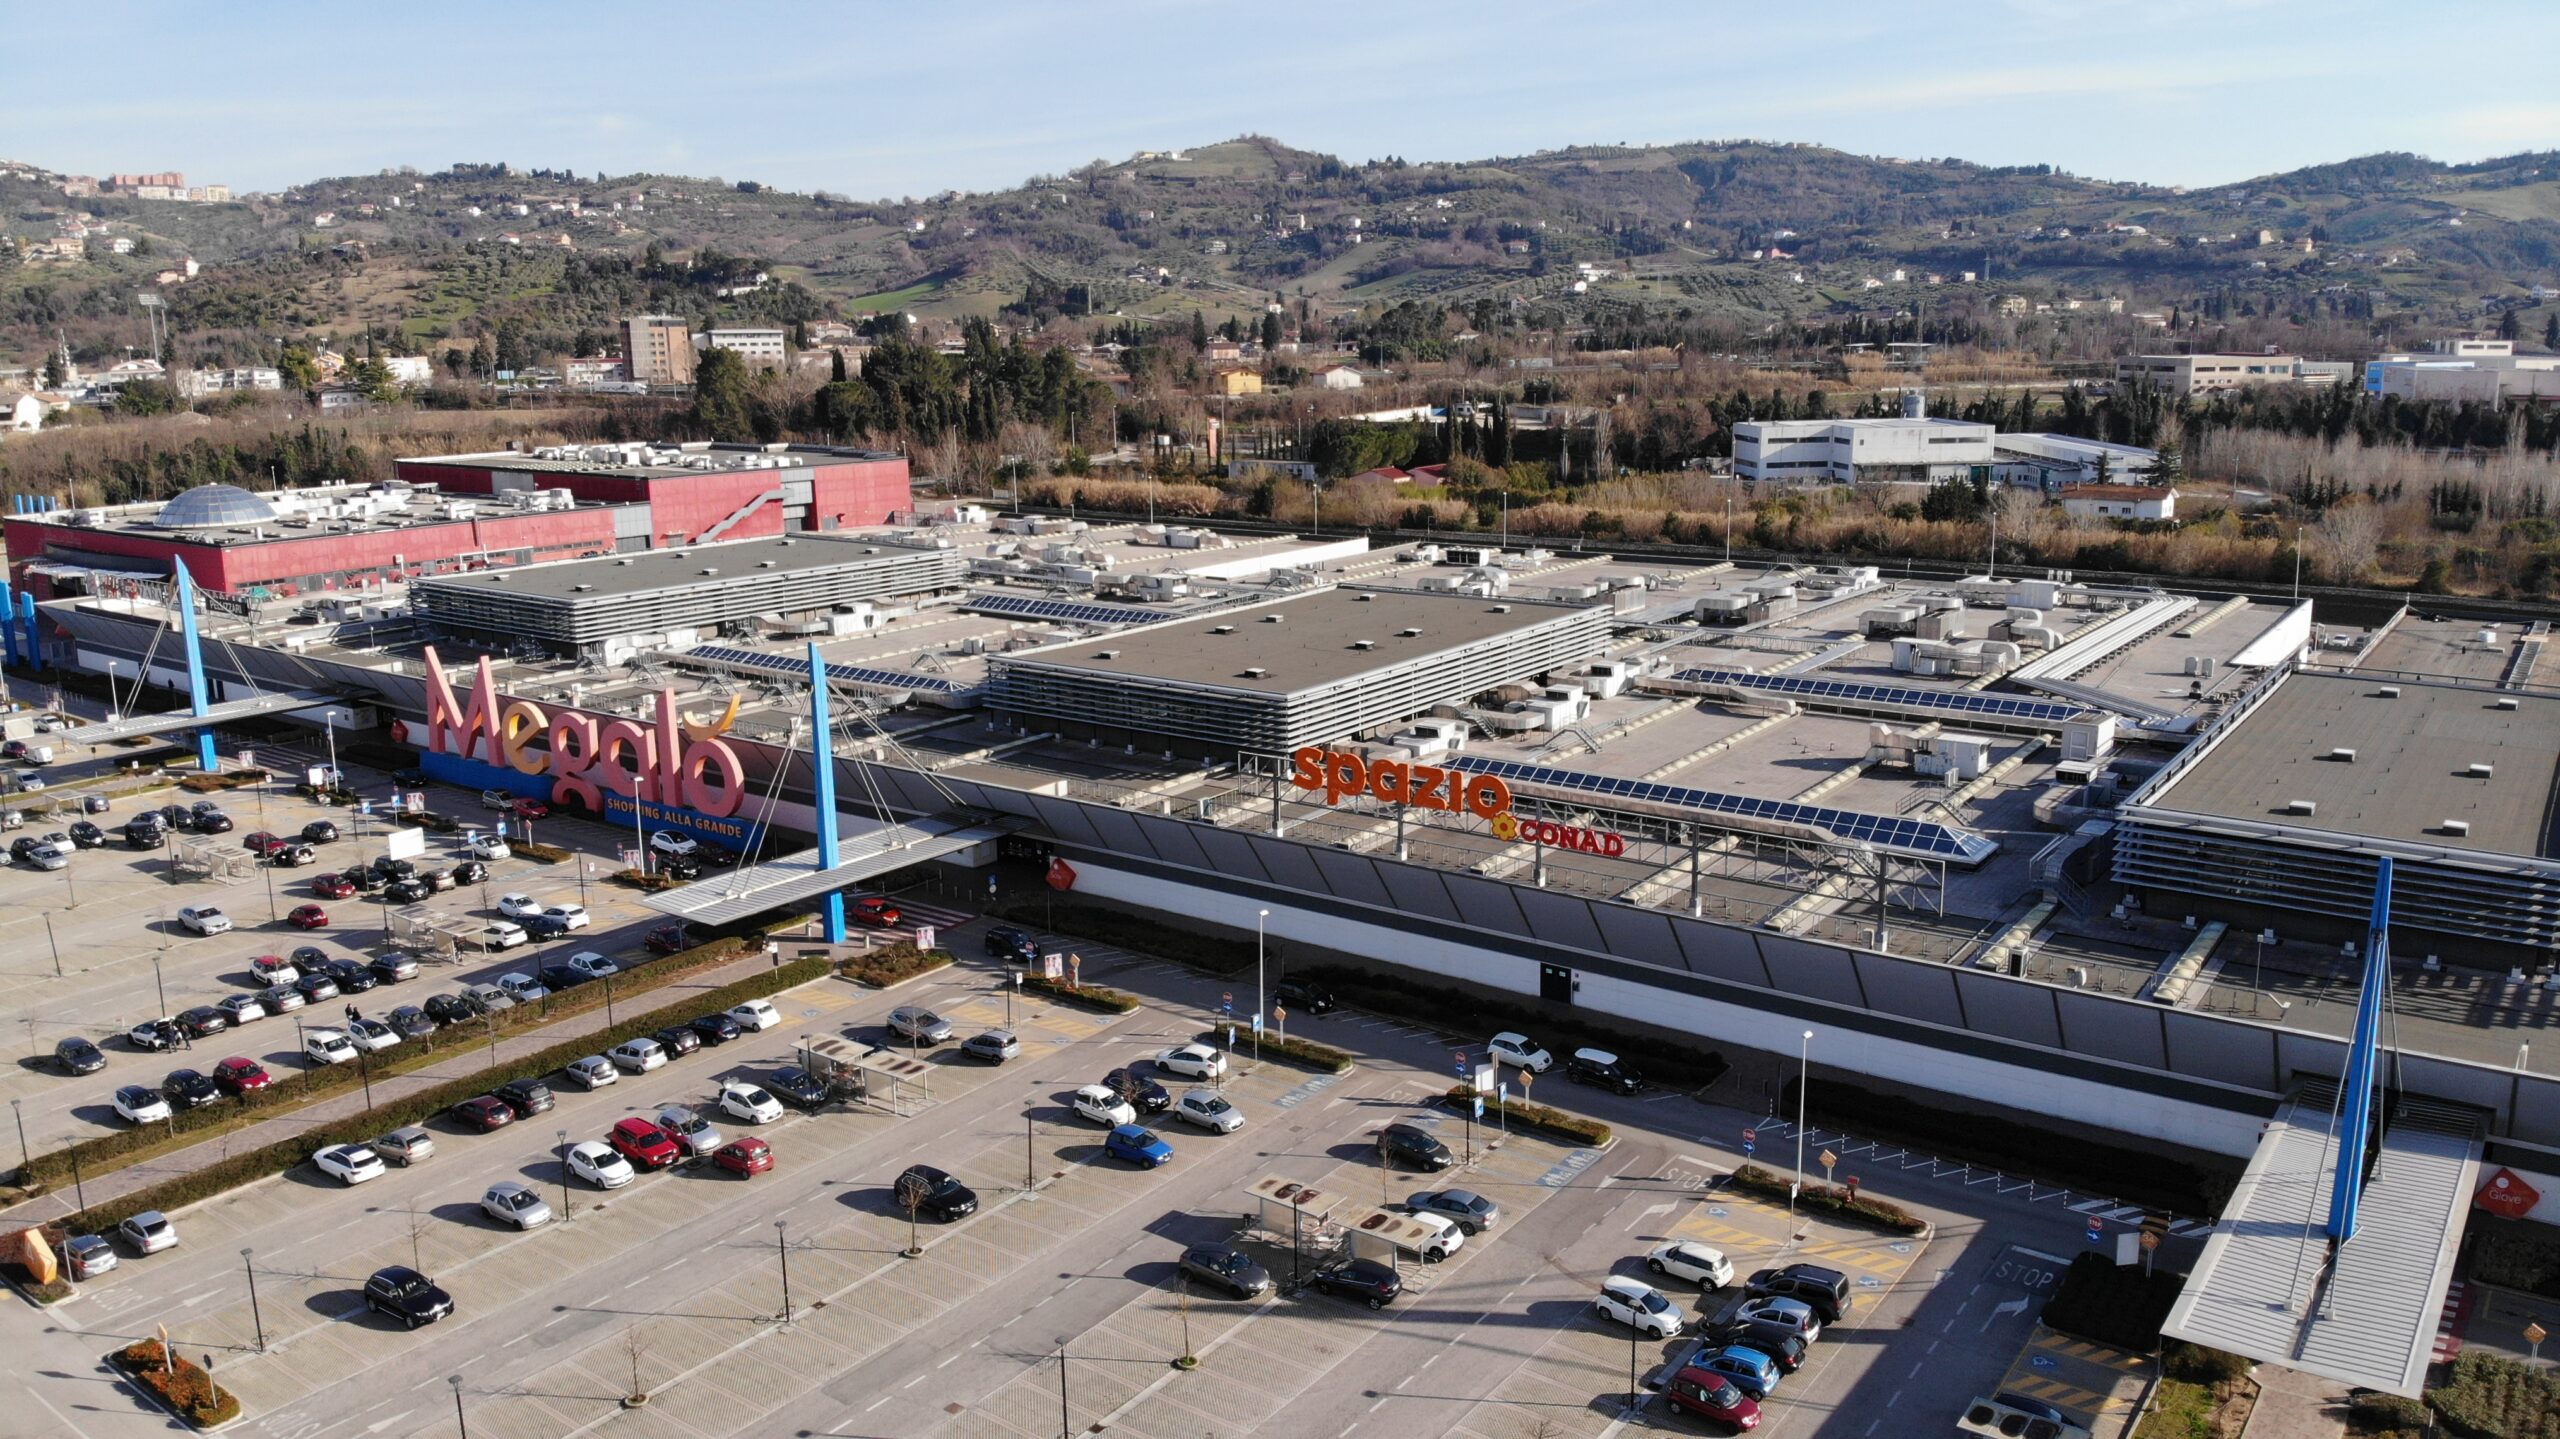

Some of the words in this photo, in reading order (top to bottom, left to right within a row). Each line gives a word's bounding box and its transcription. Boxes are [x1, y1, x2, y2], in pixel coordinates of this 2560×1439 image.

[1293, 747, 1511, 819] spazio
[607, 798, 660, 820] SHOPING
[664, 811, 692, 827] ALLA
[695, 818, 742, 839] GRANDE
[1521, 820, 1625, 858] CONAD
[1664, 1167, 1713, 1191] STOP
[1995, 1260, 2054, 1288] STOP
